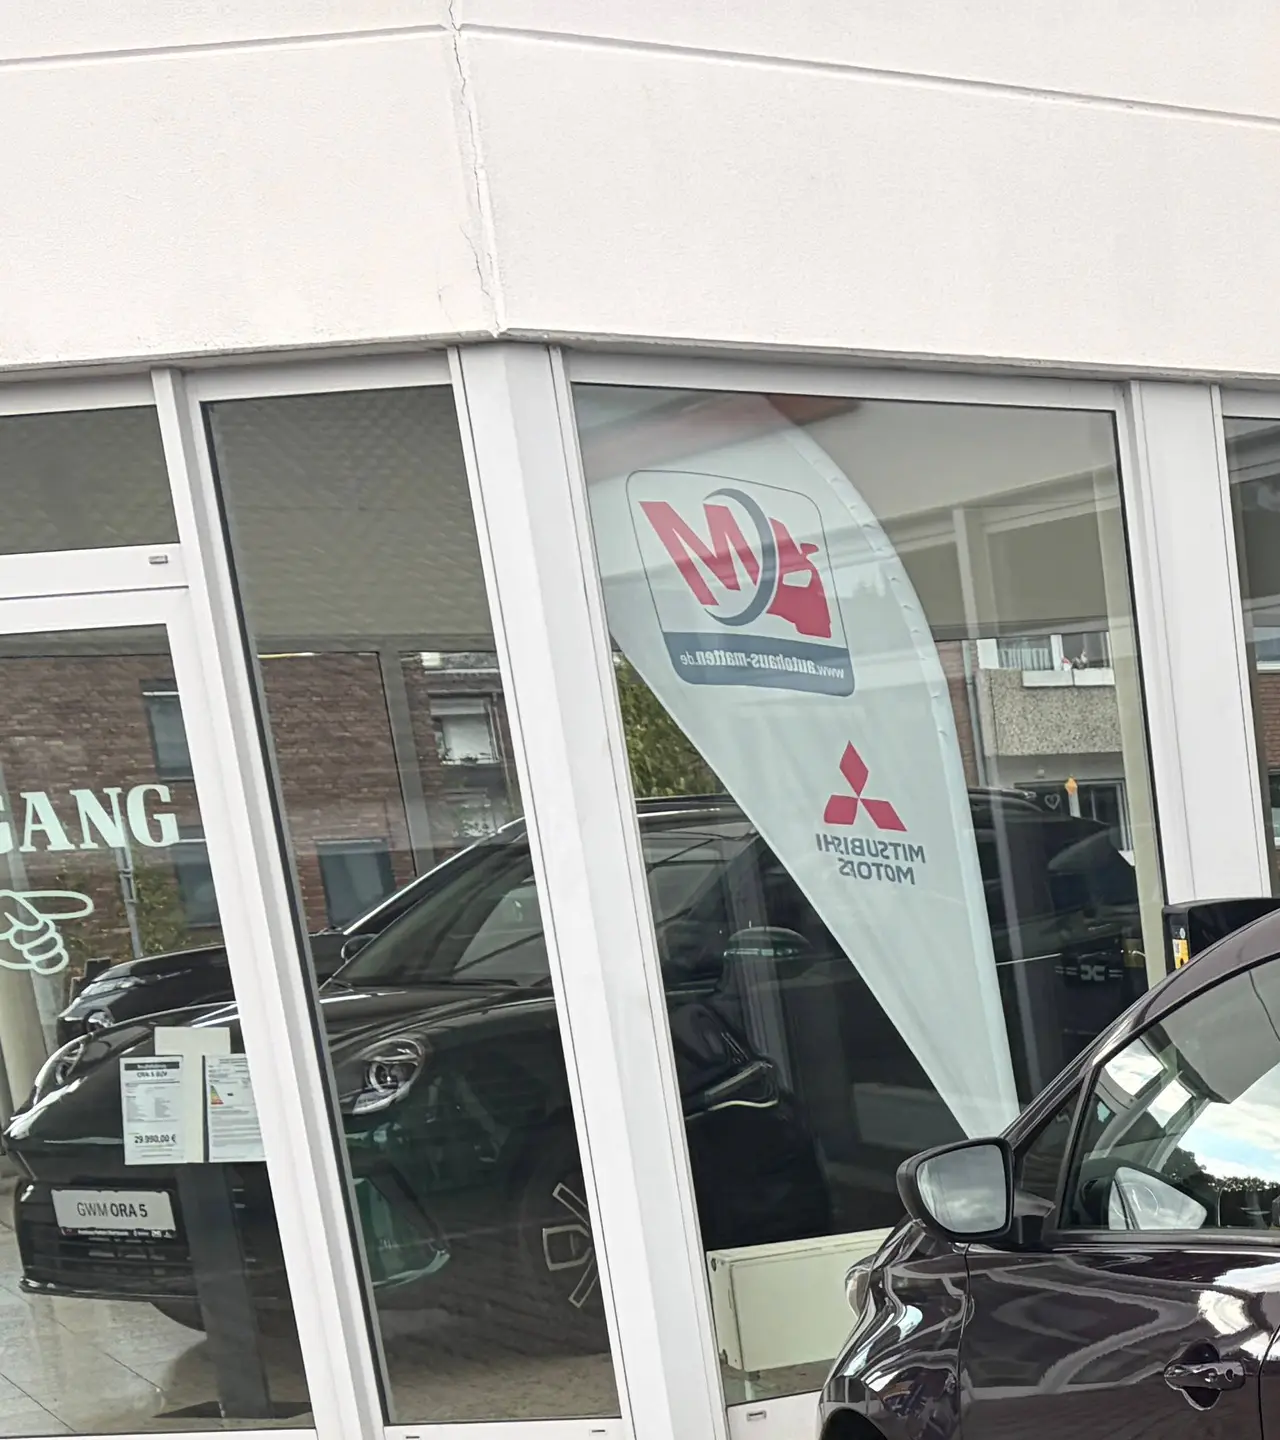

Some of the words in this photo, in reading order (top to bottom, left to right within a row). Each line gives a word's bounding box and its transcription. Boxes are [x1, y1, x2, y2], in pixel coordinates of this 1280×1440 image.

[0, 784, 180, 854] ANG
[77, 1202, 109, 1217] GWM
[110, 1203, 138, 1218] ORA
[139, 1203, 148, 1218] 5
